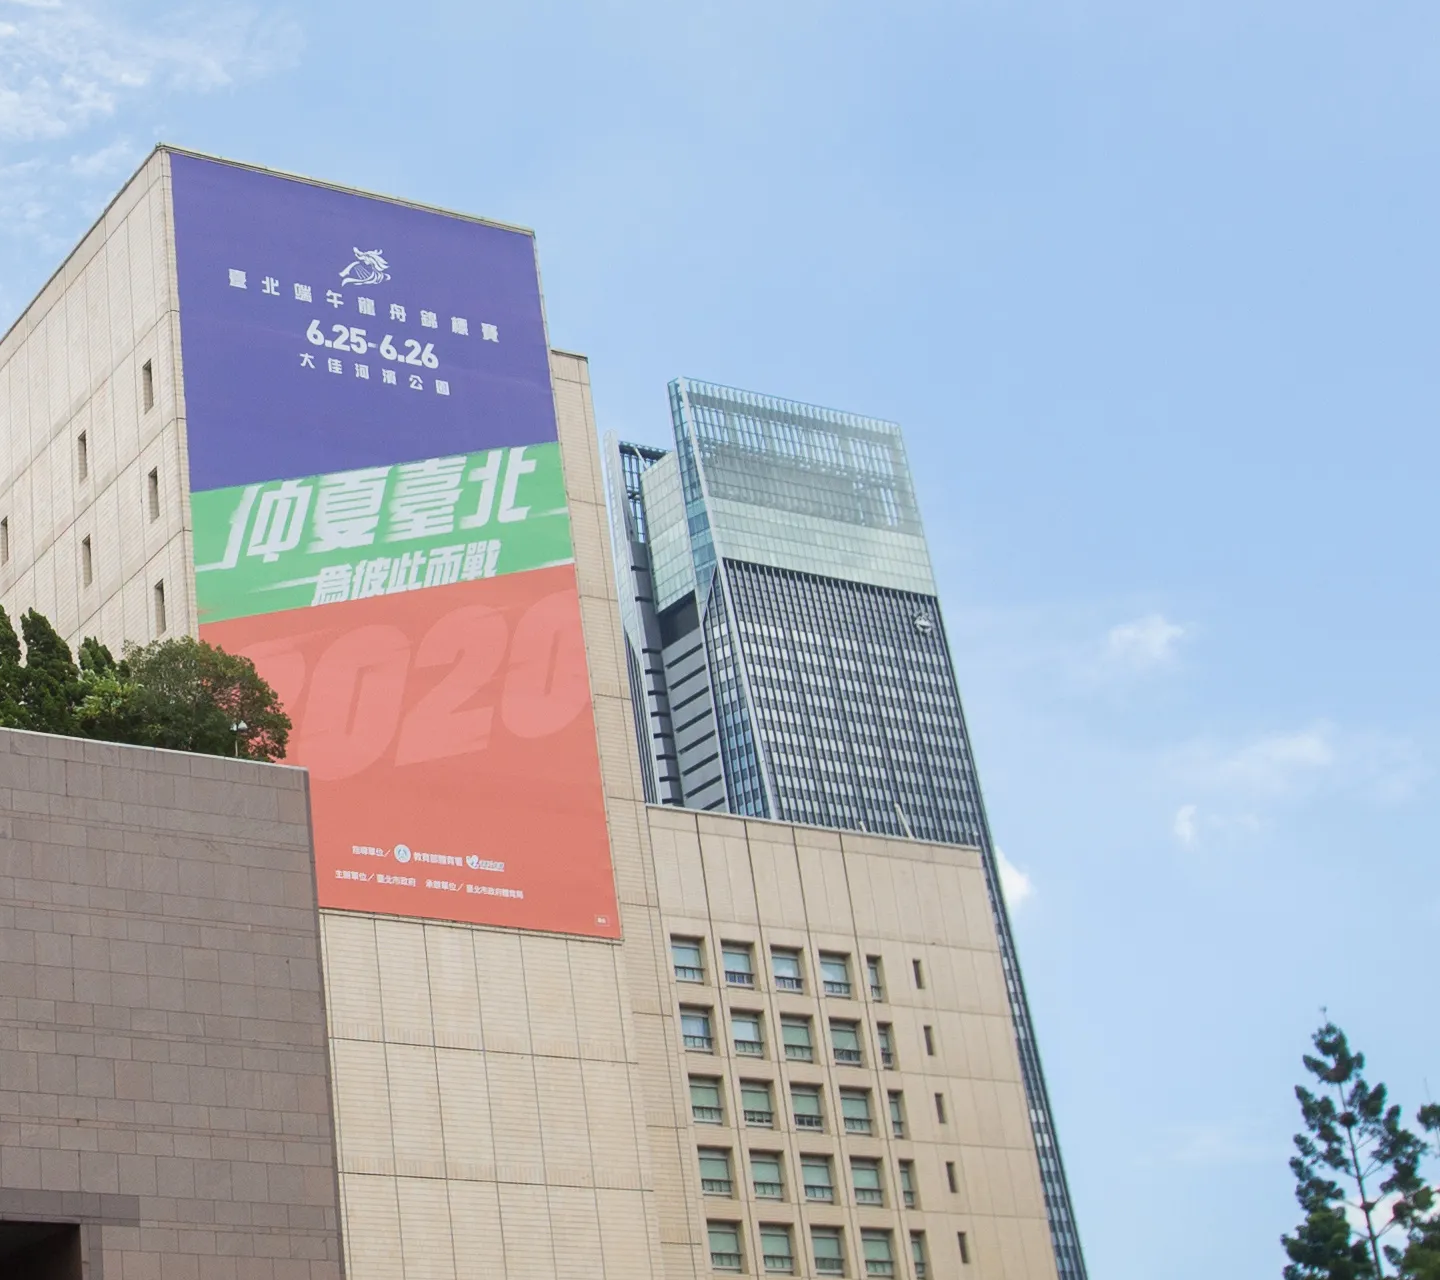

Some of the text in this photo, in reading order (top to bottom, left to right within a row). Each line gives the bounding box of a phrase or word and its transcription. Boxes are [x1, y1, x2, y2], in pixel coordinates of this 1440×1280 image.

[228, 268, 500, 343] 臺北端午龍舟錦標賽
[299, 352, 451, 396] 大佳河濱公園
[306, 319, 439, 369] 6.25-6.26
[218, 446, 537, 570] 仲夏臺北
